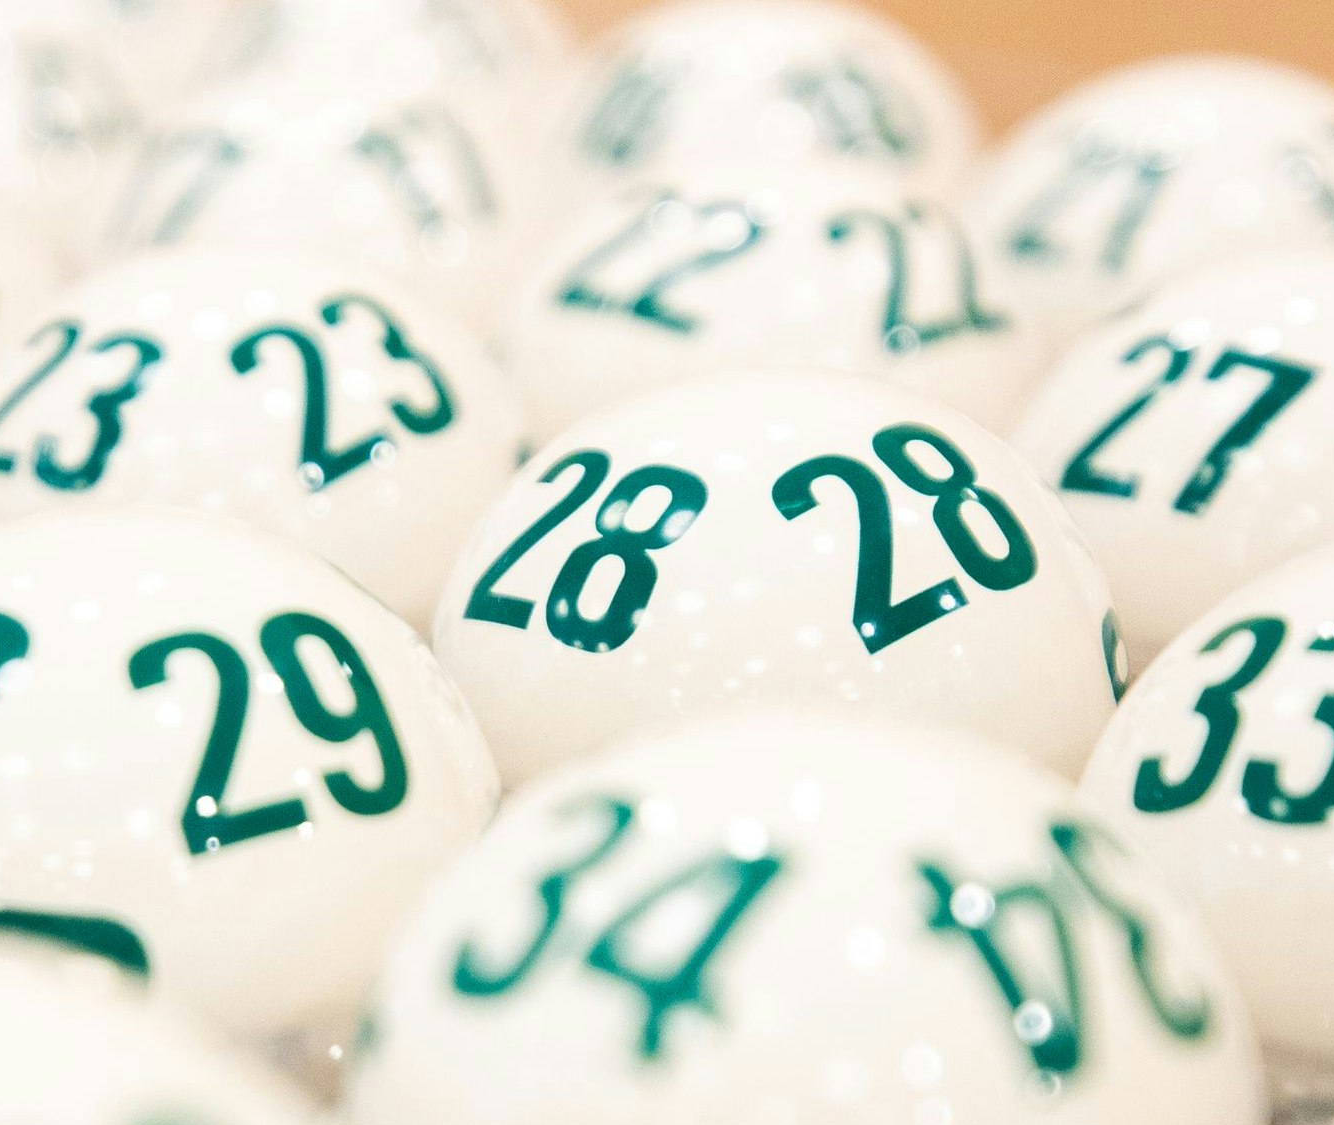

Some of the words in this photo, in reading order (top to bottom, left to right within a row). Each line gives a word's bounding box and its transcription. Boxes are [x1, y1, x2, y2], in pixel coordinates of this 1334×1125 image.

[225, 288, 462, 492] 23
[1059, 330, 1325, 518] 27
[460, 447, 712, 655] 28
[767, 420, 1042, 658] 28
[125, 608, 412, 858] 29
[445, 792, 792, 1070] 34
